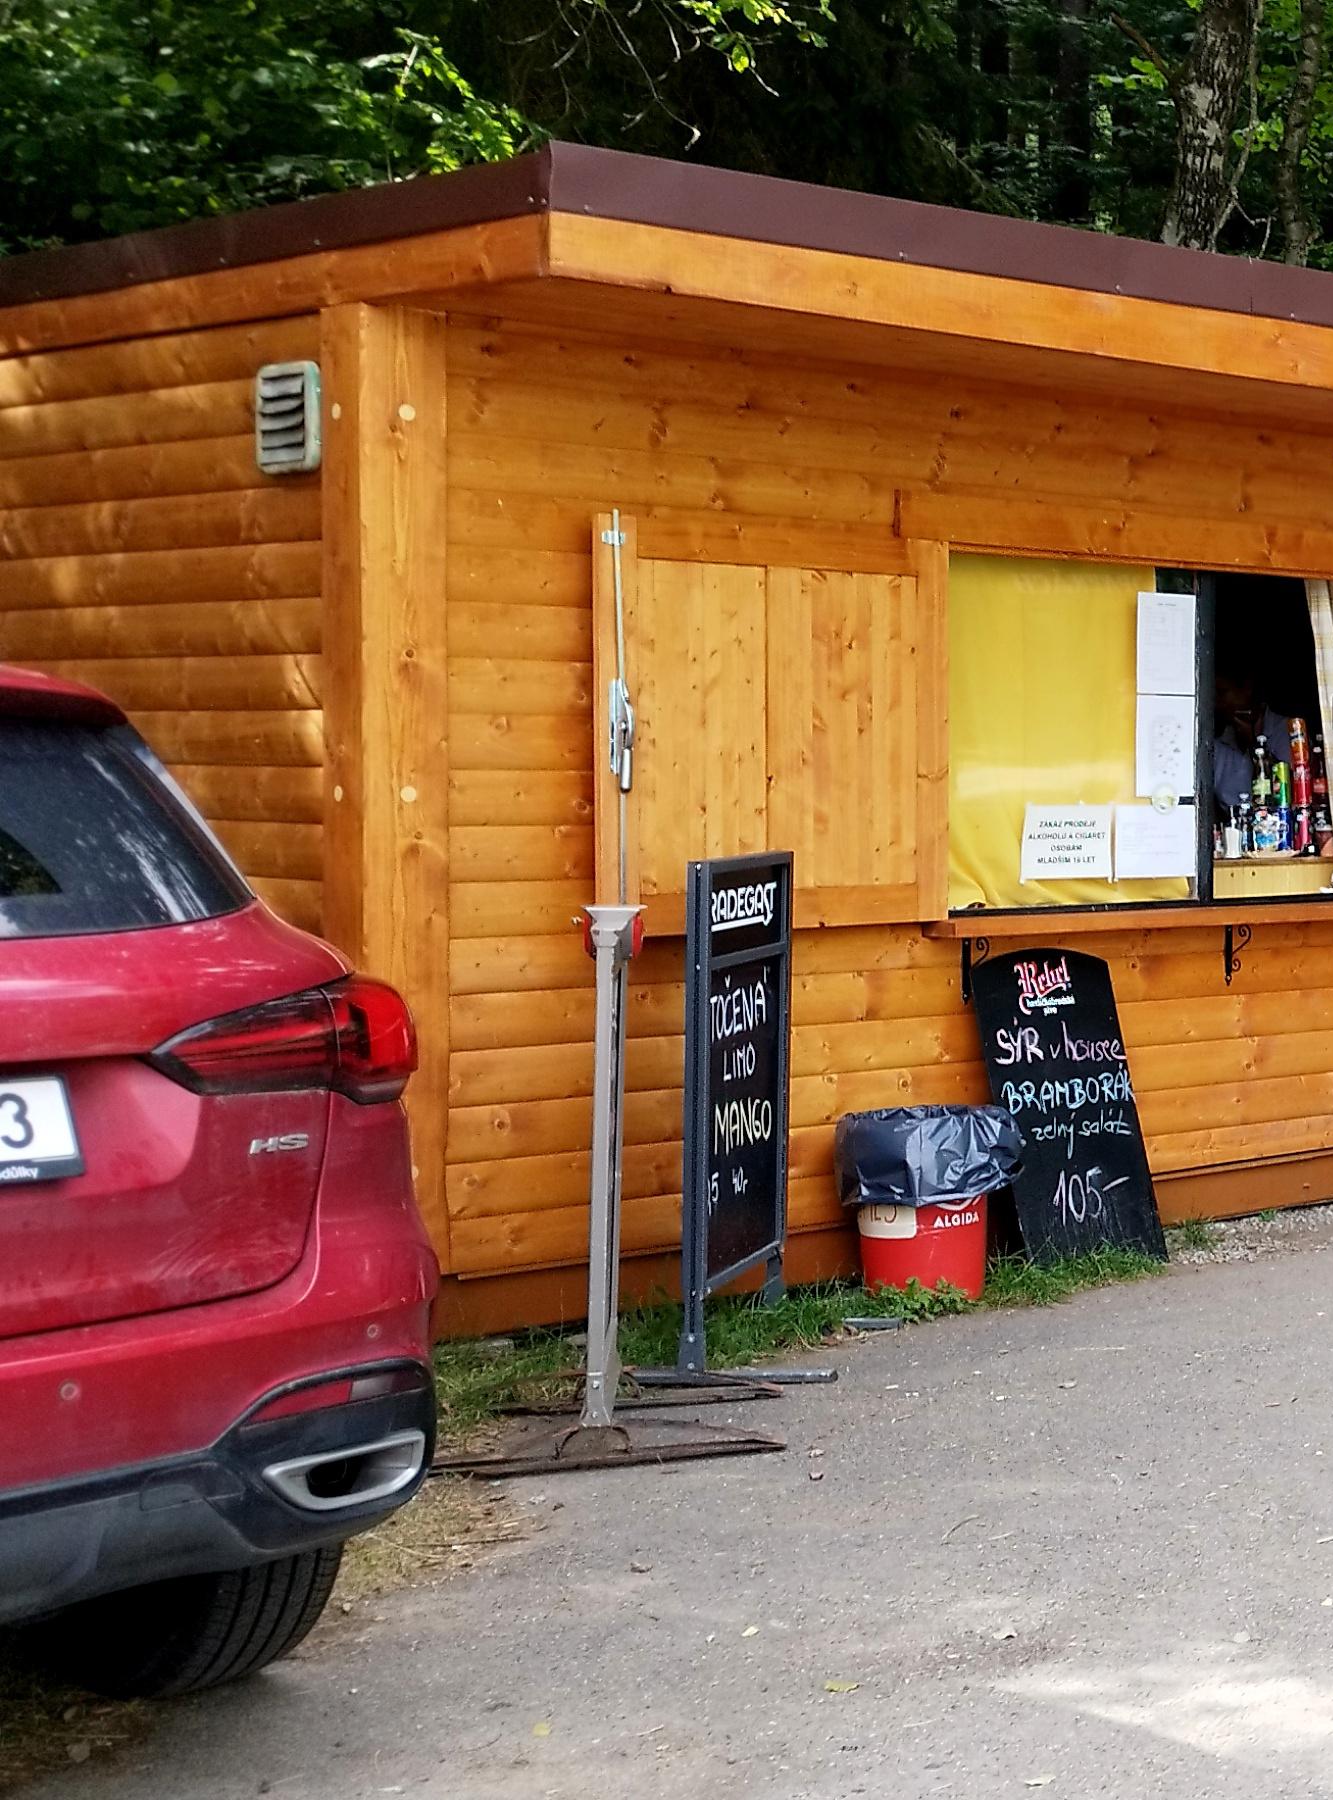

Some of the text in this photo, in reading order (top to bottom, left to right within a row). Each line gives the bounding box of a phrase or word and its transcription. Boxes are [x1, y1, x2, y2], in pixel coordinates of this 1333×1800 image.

[710, 966, 768, 1043] TOČENÁ
[994, 1016, 1044, 1065] SÝR
[1049, 1042, 1061, 1059] v
[249, 1133, 309, 1155] HS
[714, 1097, 772, 1156] MANGO
[933, 1211, 980, 1229] ALGIDA
